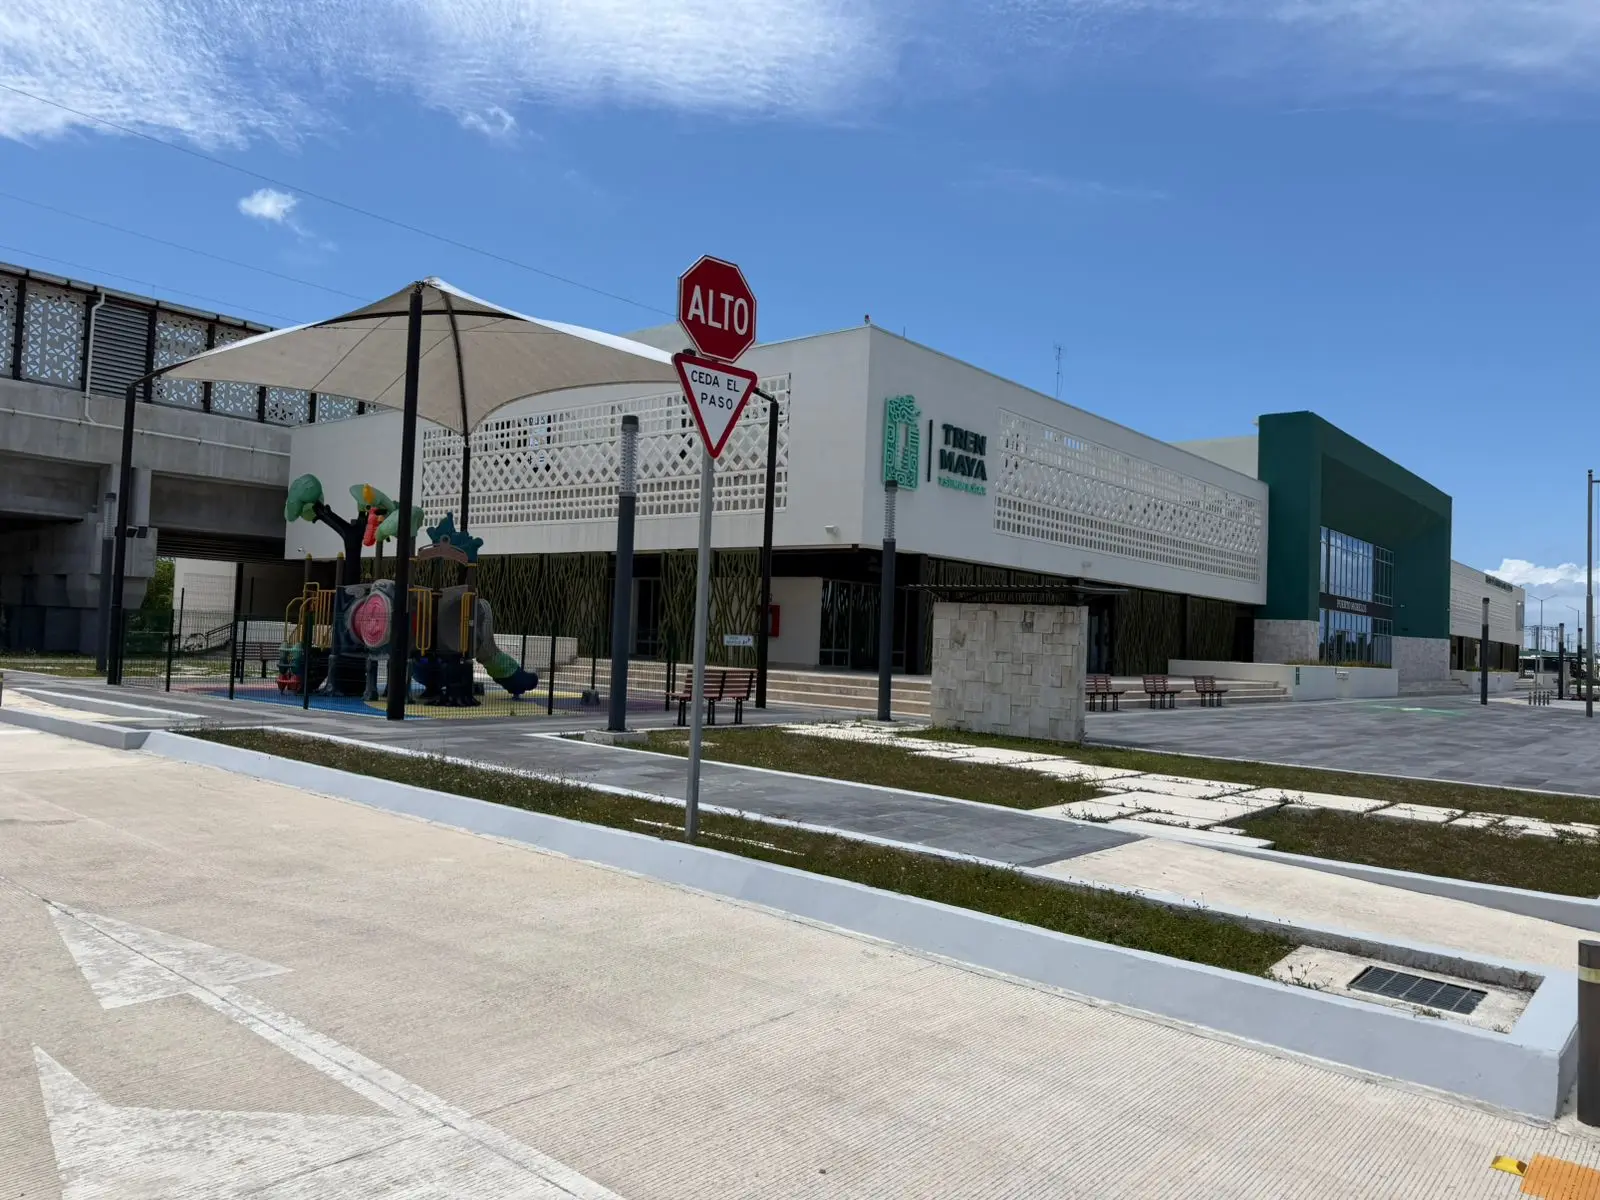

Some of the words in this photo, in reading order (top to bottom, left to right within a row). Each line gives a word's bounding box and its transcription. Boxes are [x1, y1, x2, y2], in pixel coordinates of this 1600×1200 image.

[687, 285, 749, 336] ALTO
[690, 370, 720, 389] CEDA
[726, 378, 740, 393] EL
[700, 392, 734, 411] PASO
[942, 423, 987, 456] TREN
[939, 448, 988, 481] MAYA
